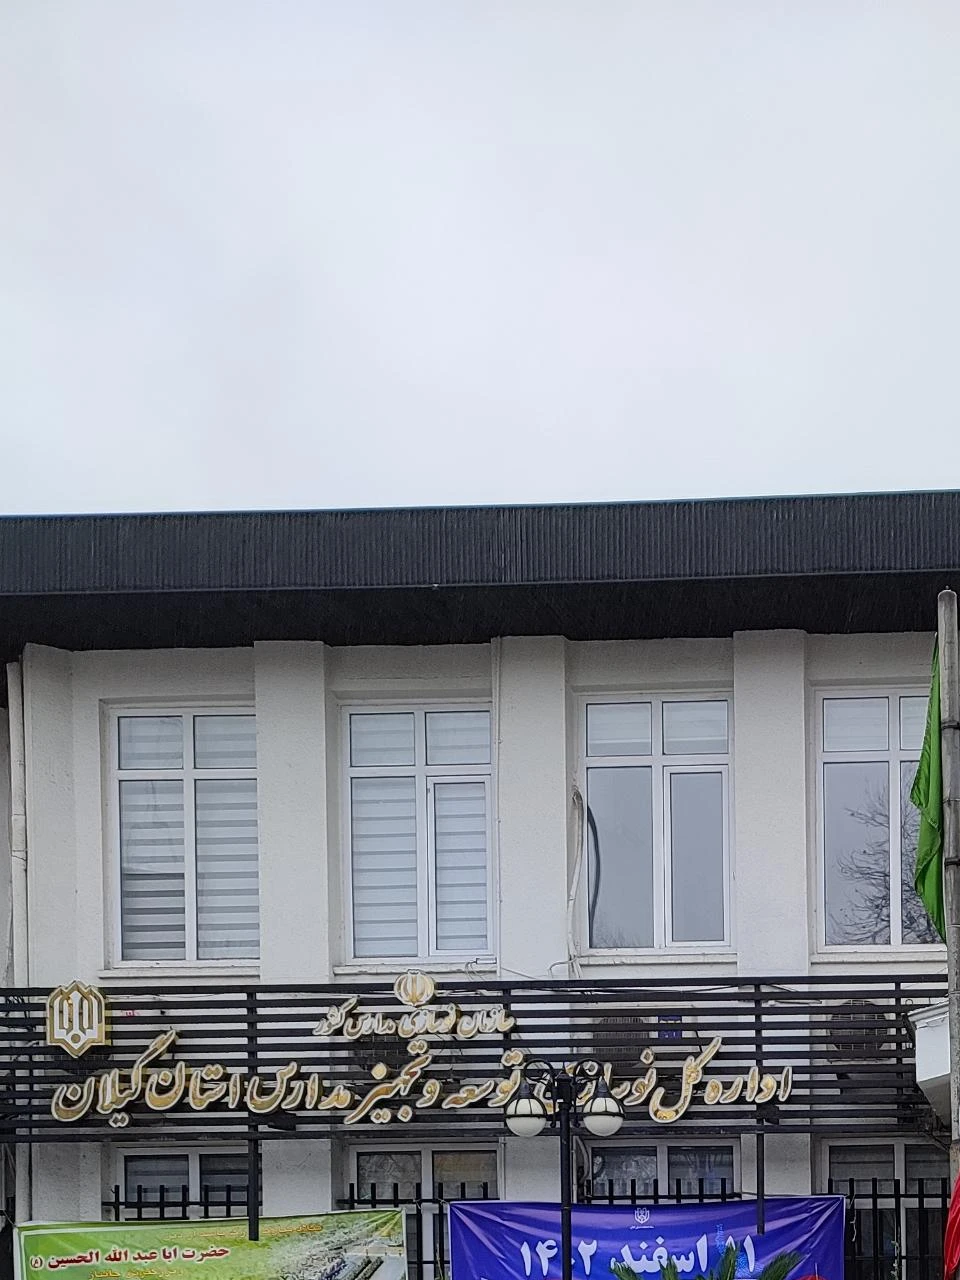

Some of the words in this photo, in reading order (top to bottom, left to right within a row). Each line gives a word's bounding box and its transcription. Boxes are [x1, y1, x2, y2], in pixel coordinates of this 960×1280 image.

[51, 1027, 180, 1128] گیلان
[144, 1060, 242, 1112] استان
[247, 1061, 350, 1114] مدارس
[343, 1039, 432, 1125] تجهیز
[416, 1078, 441, 1108] و
[649, 1036, 722, 1124] کل
[704, 1066, 793, 1105] اداره
[48, 1251, 99, 1269] الحسین
[181, 1244, 230, 1262] حضرت
